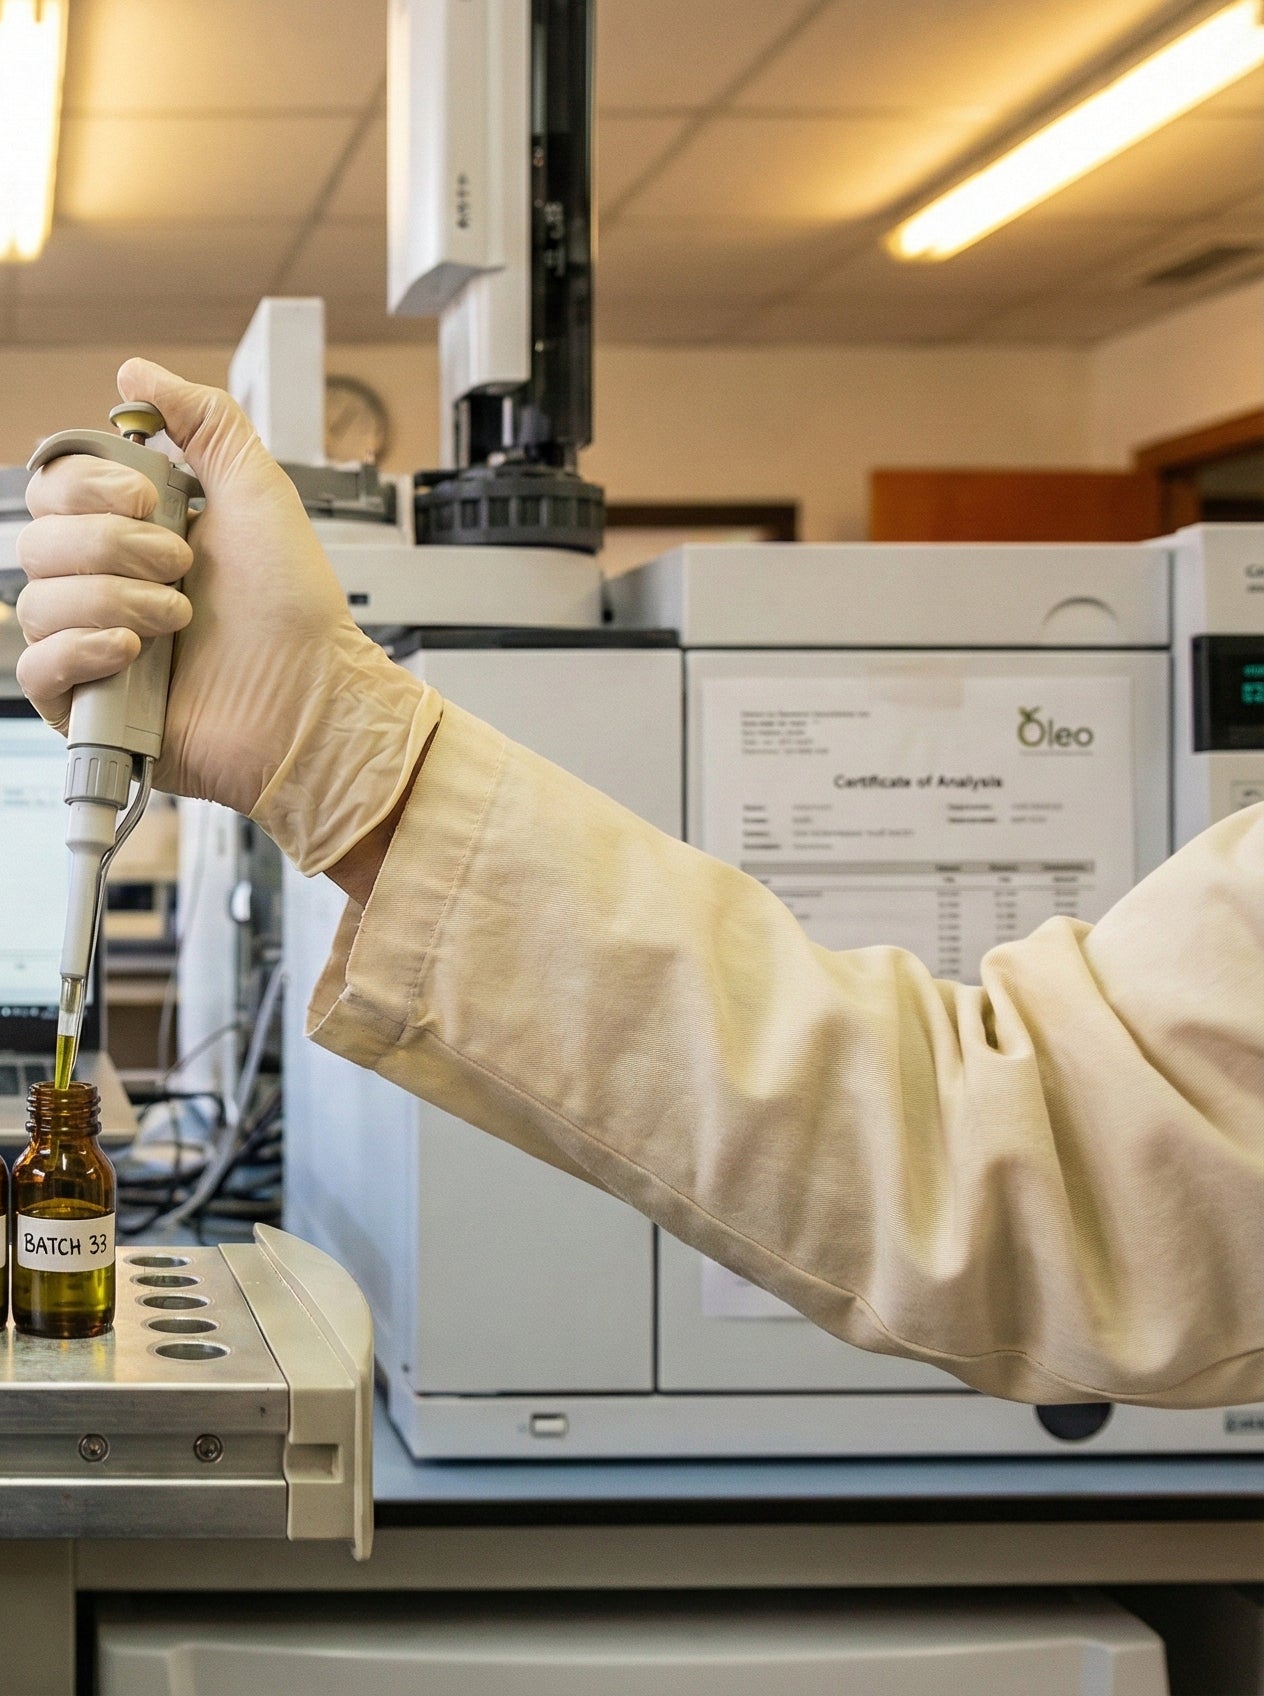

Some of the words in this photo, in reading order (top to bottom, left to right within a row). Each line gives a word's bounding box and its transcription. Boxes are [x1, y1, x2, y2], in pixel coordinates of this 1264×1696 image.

[834, 774, 911, 790] Certificate
[917, 774, 934, 790] of
[938, 773, 1004, 791] Analysis
[24, 1233, 81, 1256] BATCH
[89, 1234, 107, 1254] 33
